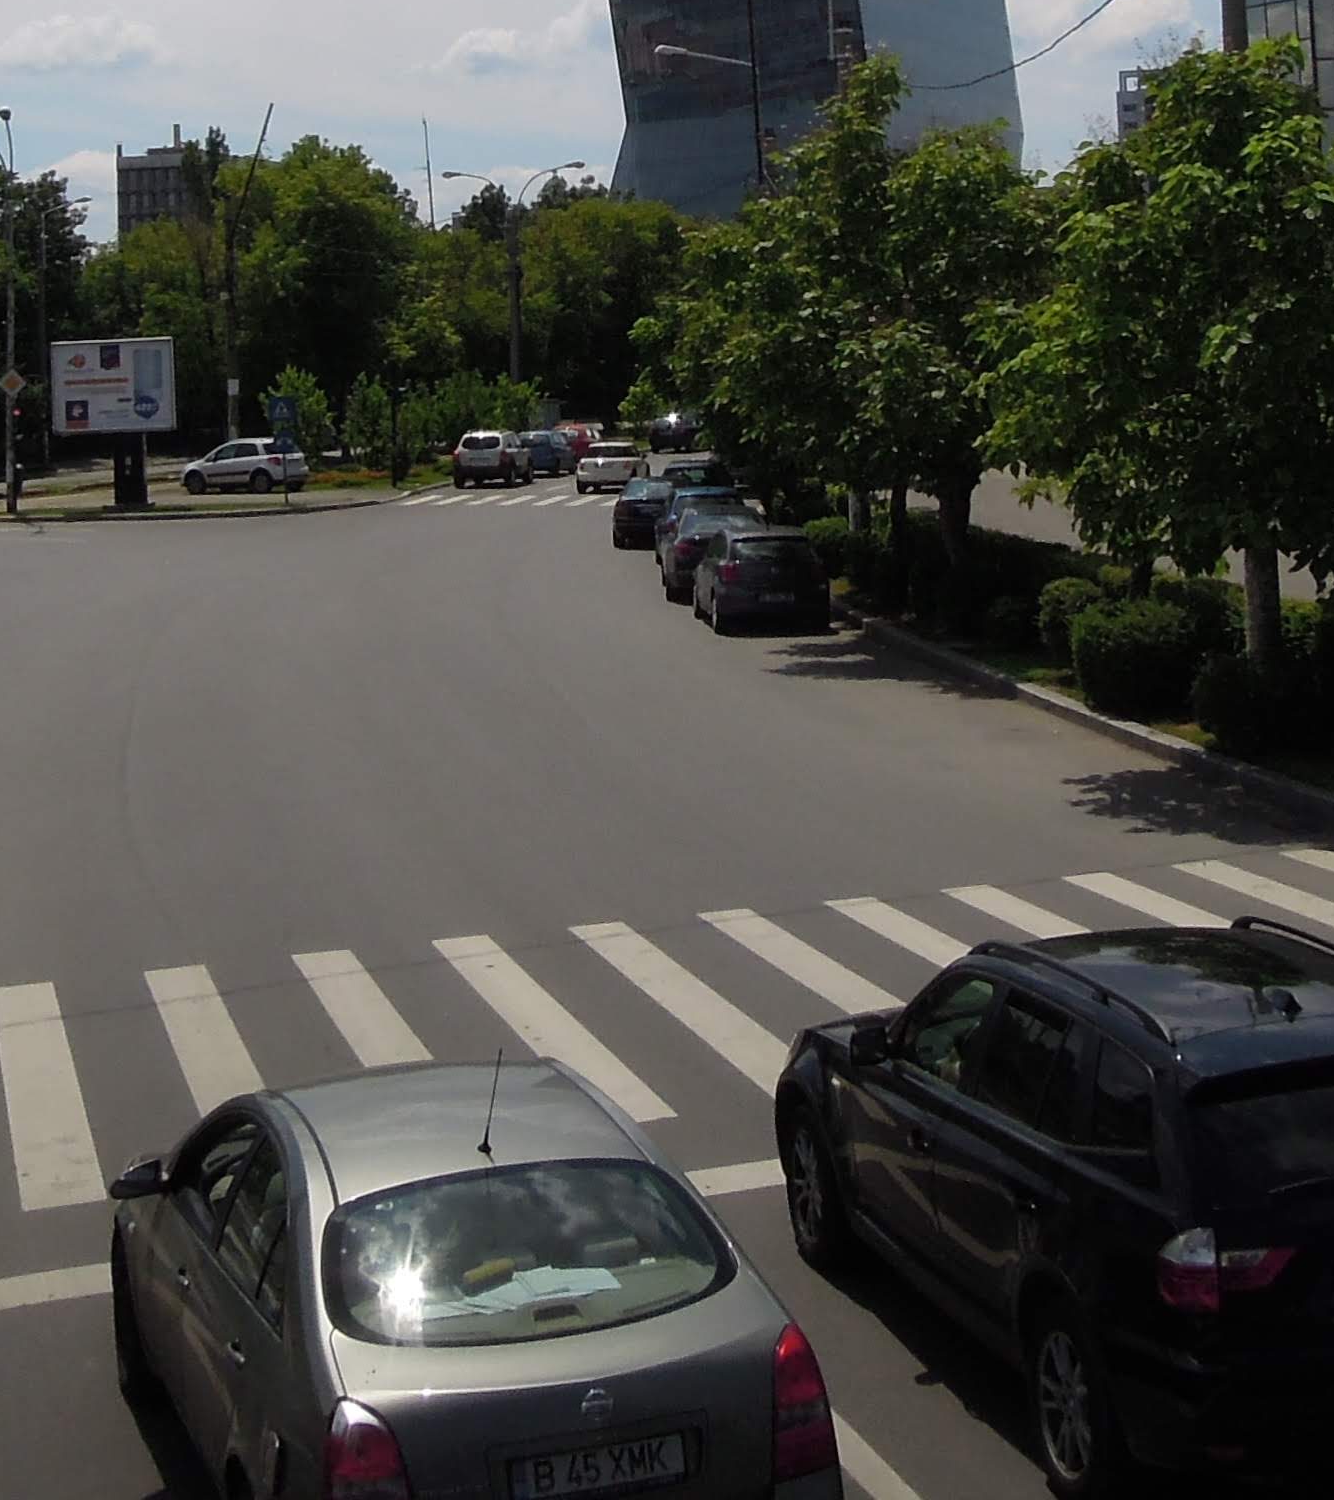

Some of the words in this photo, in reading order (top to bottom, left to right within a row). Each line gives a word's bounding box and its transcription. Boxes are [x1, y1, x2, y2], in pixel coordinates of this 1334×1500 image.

[533, 1459, 555, 1493] B
[568, 1452, 601, 1486] 45
[608, 1440, 668, 1481] XMK
